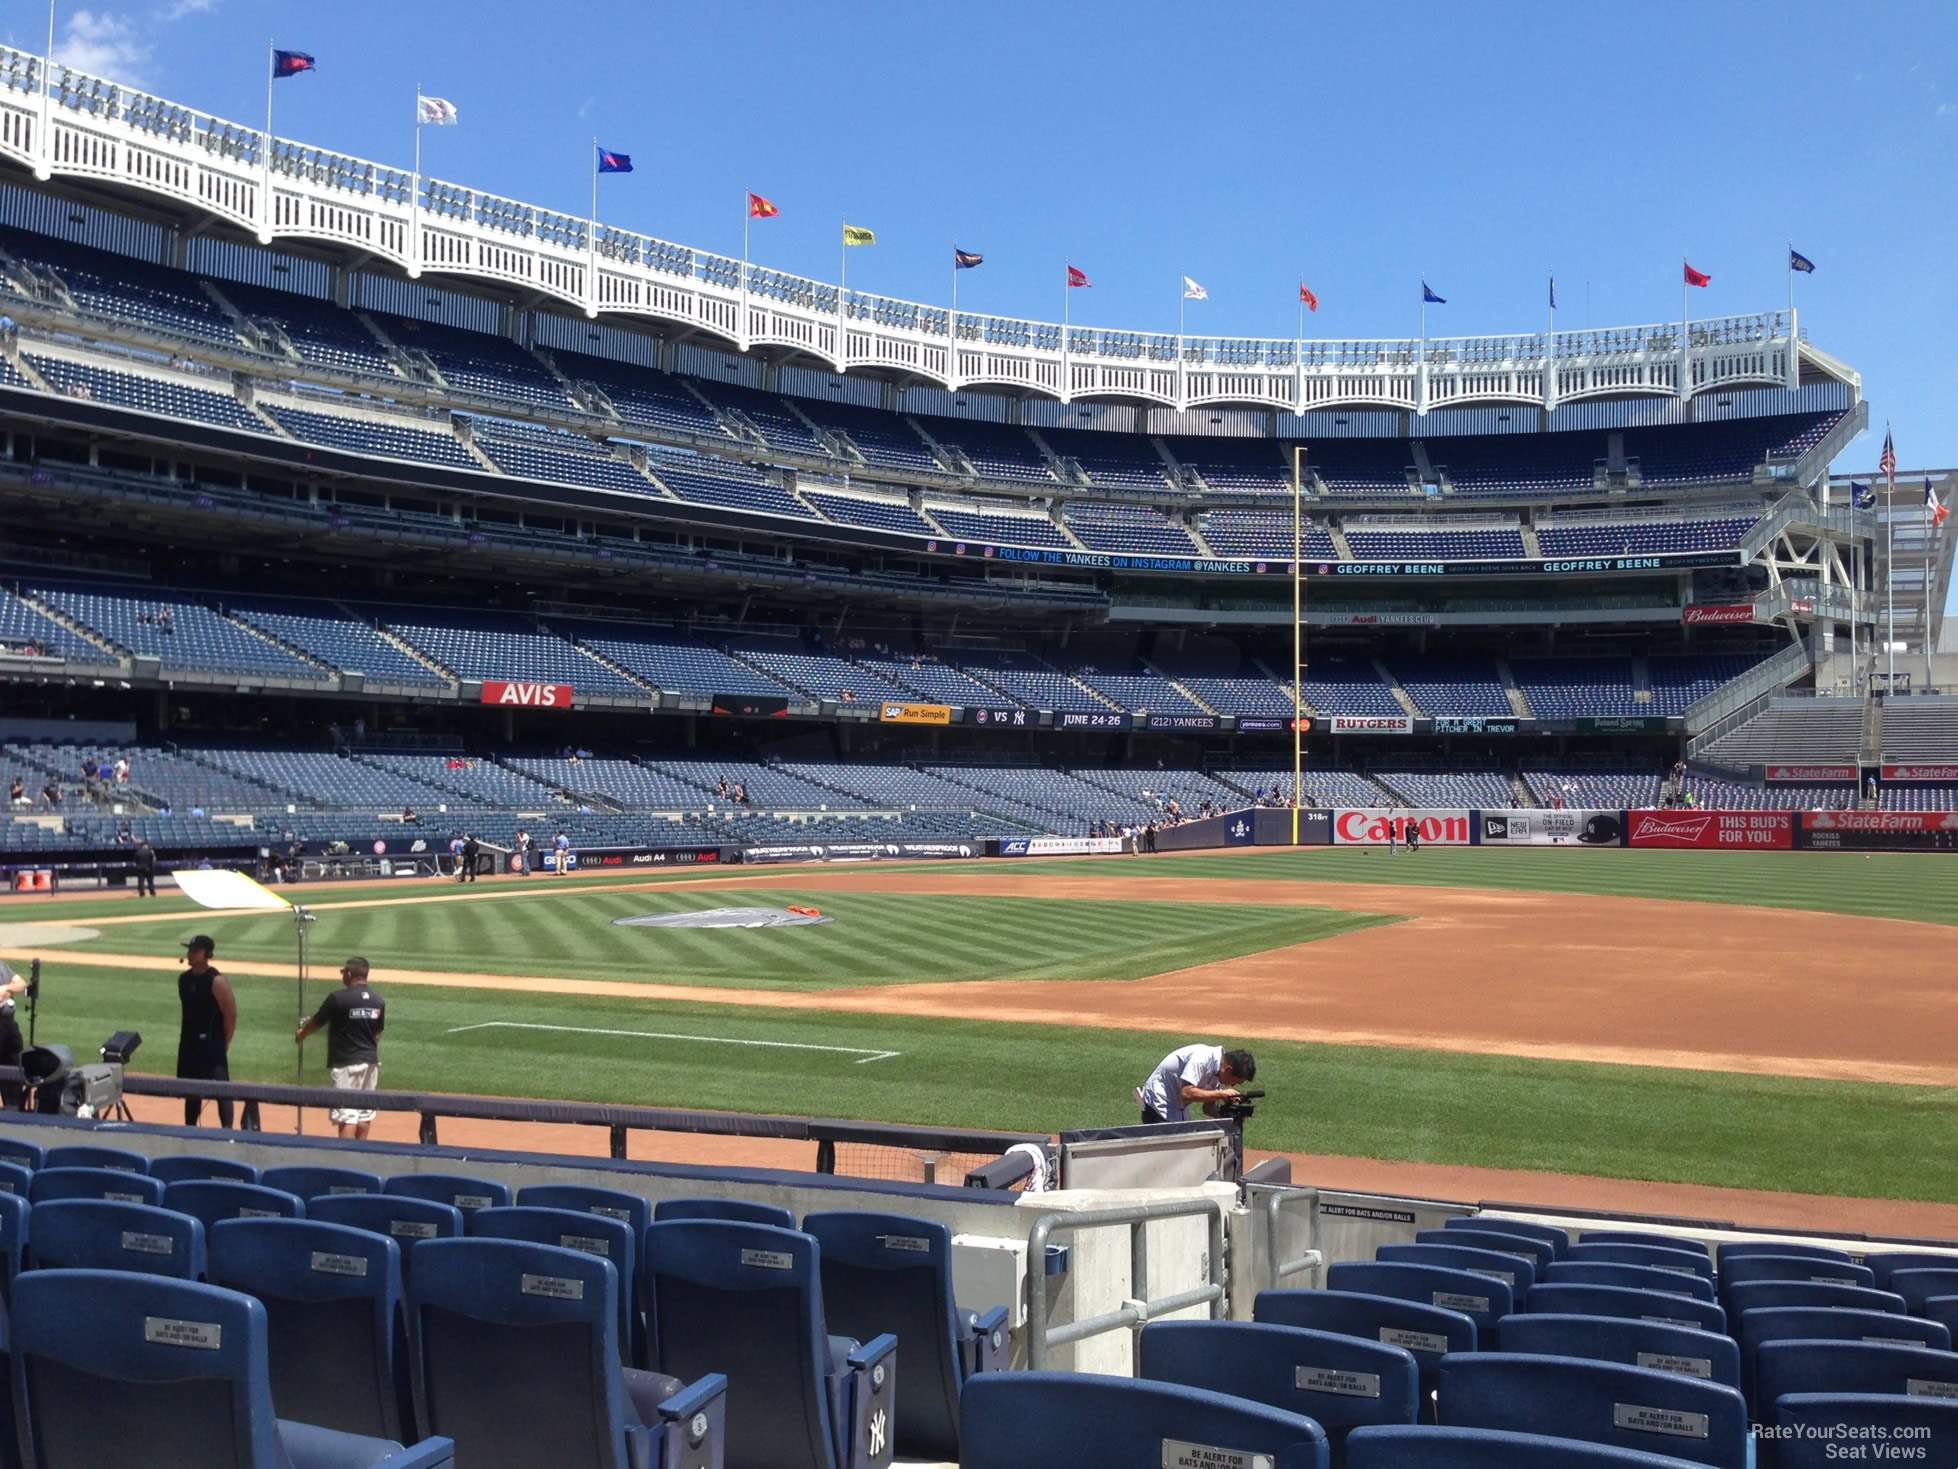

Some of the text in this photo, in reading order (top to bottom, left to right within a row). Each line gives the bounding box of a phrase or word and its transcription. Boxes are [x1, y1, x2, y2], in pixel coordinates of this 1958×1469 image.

[1000, 548, 1250, 572] FOLLOW THE YANKEES ON INSTAGRAM @YANKEES
[1544, 558, 1661, 572] GEOFFREY BEENE
[1337, 564, 1444, 574] GEOFFREY BEENE
[1352, 615, 1434, 624] Audi YANKEES CLUB
[1684, 609, 1752, 622] Budweiser
[500, 684, 556, 706] AVIS
[885, 706, 946, 720] SAP Run Simple
[994, 712, 1008, 722] VS
[1064, 714, 1120, 726] JUNE 24-26
[1151, 717, 1214, 728] (212) YANKEES
[1242, 720, 1280, 729] yankees.com
[1336, 719, 1406, 728] RUTGERS
[1594, 718, 1644, 728] Poland Spring
[1911, 768, 1958, 778] StateFar
[1336, 811, 1467, 841] Canon
[1718, 816, 1788, 828] THIS BUD'S
[1640, 821, 1702, 834] Budweiser
[1718, 830, 1776, 842] FOR YOU.
[903, 844, 959, 852] WEATHERPROOF
[1005, 842, 1026, 850] ACC
[544, 856, 576, 864] GEO
[603, 856, 624, 864] Audi
[633, 854, 665, 862] Audi A4
[698, 852, 717, 861] Audi
[1372, 1212, 1392, 1220] AND/OR
[1394, 1213, 1411, 1221] BALLS
[1326, 1374, 1344, 1382] ALERT
[1308, 1378, 1366, 1392] BATS AND/OR BALLS
[1649, 1412, 1669, 1421] ALERT
[1628, 1416, 1694, 1432] BATS AND/OR BALLS
[1178, 1457, 1198, 1468] BATS
[1192, 1449, 1243, 1466] BE ALERT FOR
